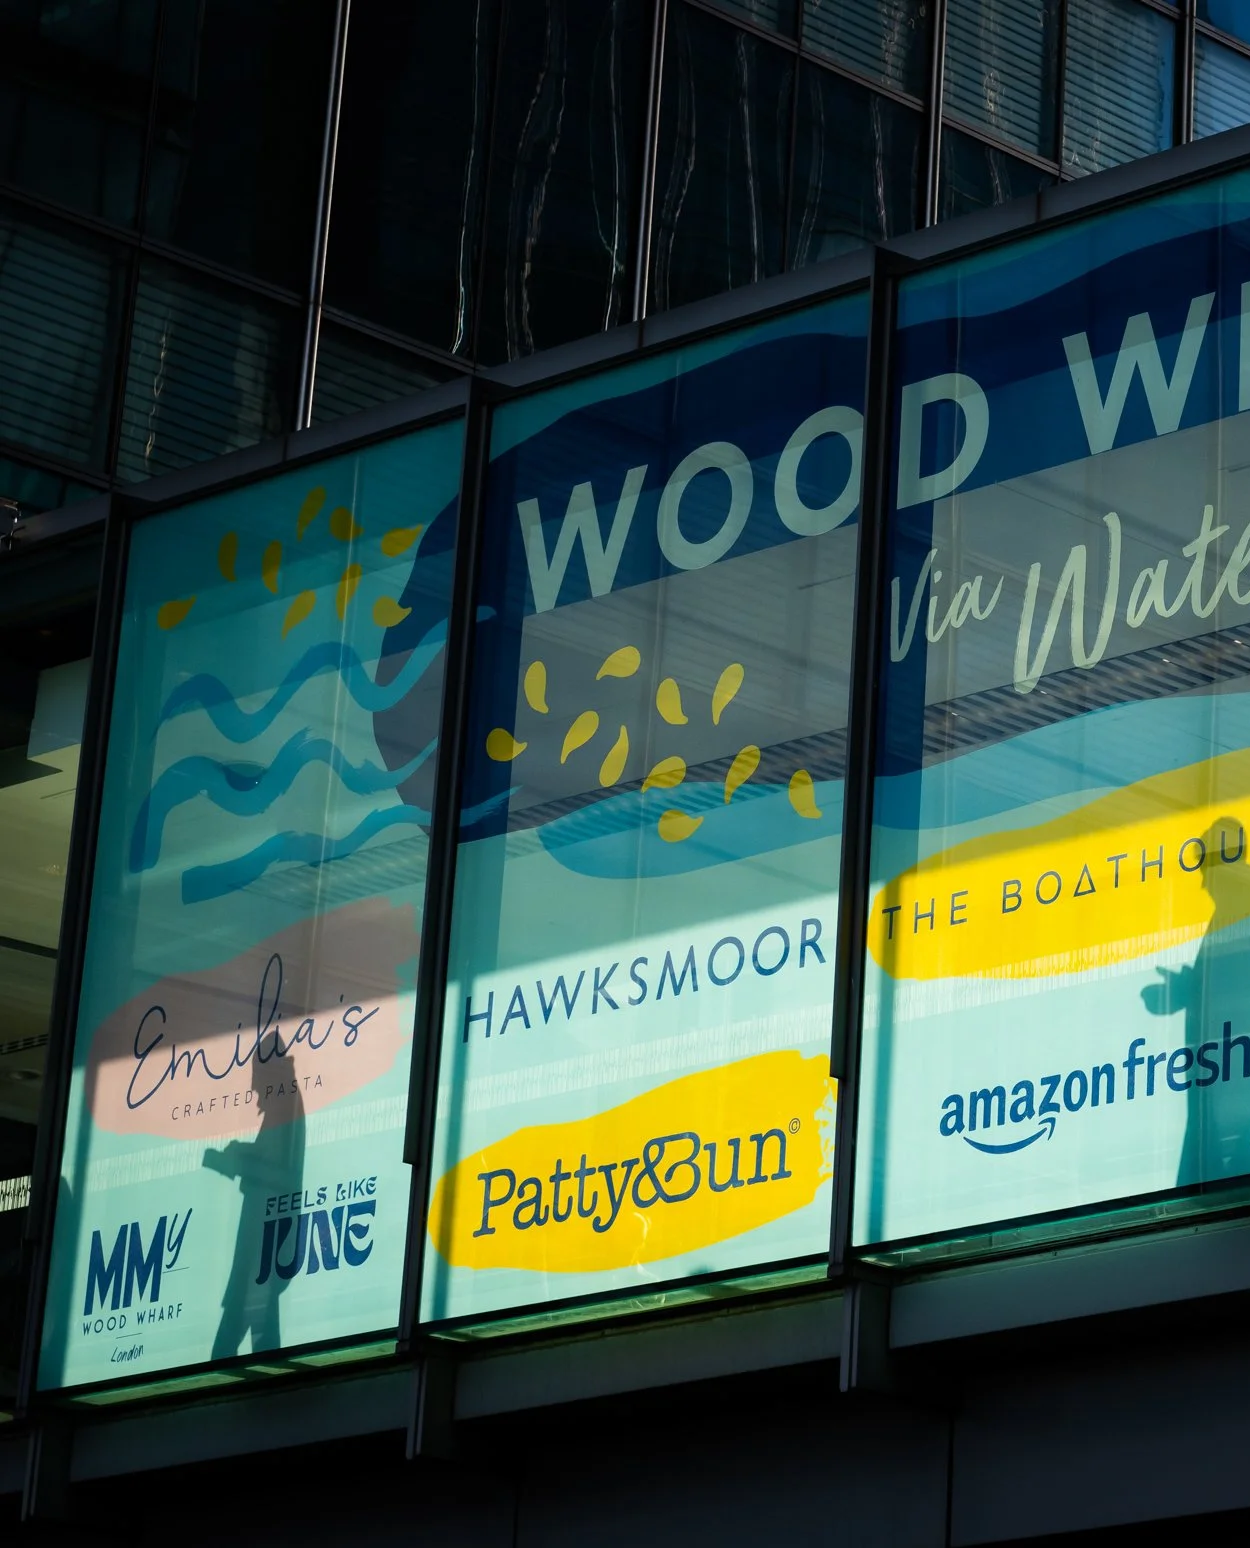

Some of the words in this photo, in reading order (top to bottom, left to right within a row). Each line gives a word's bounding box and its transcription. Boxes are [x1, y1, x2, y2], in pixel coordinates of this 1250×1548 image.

[517, 373, 989, 613] WOOD
[890, 549, 1003, 662] Via
[882, 890, 969, 940] THE
[463, 918, 826, 1044] HAWKSMOOR
[126, 953, 379, 1110] Emilia's
[171, 1090, 253, 1121] CRAFTED
[265, 1074, 323, 1100] PASTA
[940, 1064, 1115, 1137] amazon
[266, 1186, 328, 1216] FEELS
[336, 1175, 377, 1202] LIKE
[255, 1199, 377, 1285] JUNE
[83, 1314, 127, 1336] WOOD
[136, 1302, 183, 1326] WHARF
[110, 1344, 145, 1363] London
